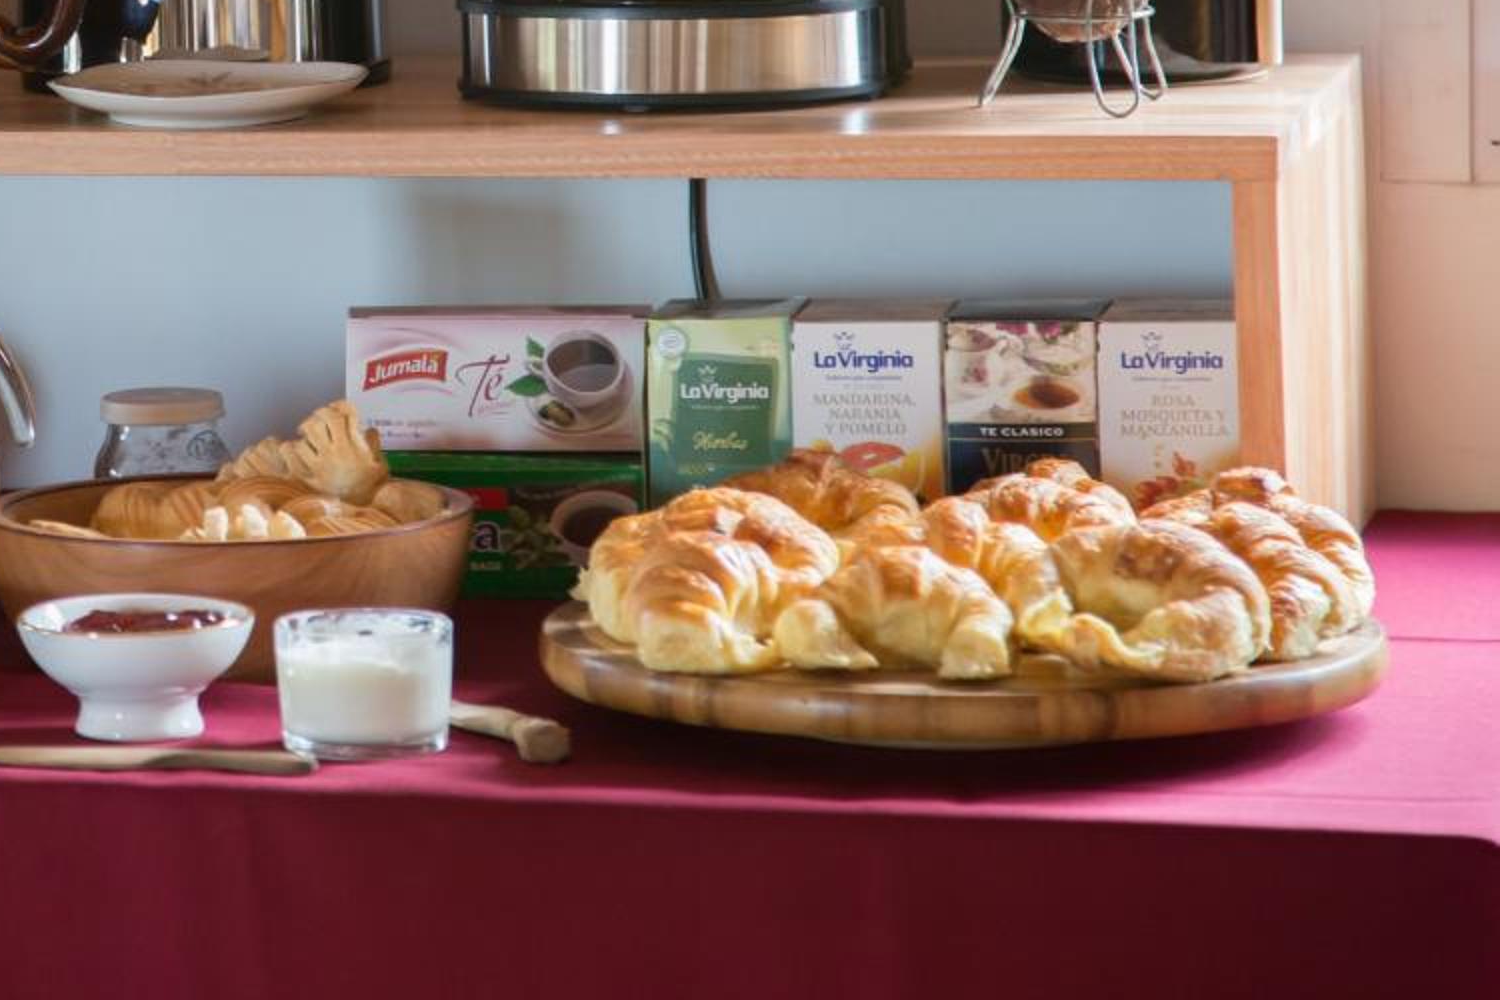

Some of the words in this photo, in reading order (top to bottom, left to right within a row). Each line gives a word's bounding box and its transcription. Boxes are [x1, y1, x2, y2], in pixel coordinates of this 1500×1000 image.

[456, 353, 511, 418] Té
[840, 423, 907, 436] POMELO
[980, 427, 995, 437] TE
[1001, 427, 1064, 437] CLASICO
[1121, 424, 1228, 437] MANZANILLA
